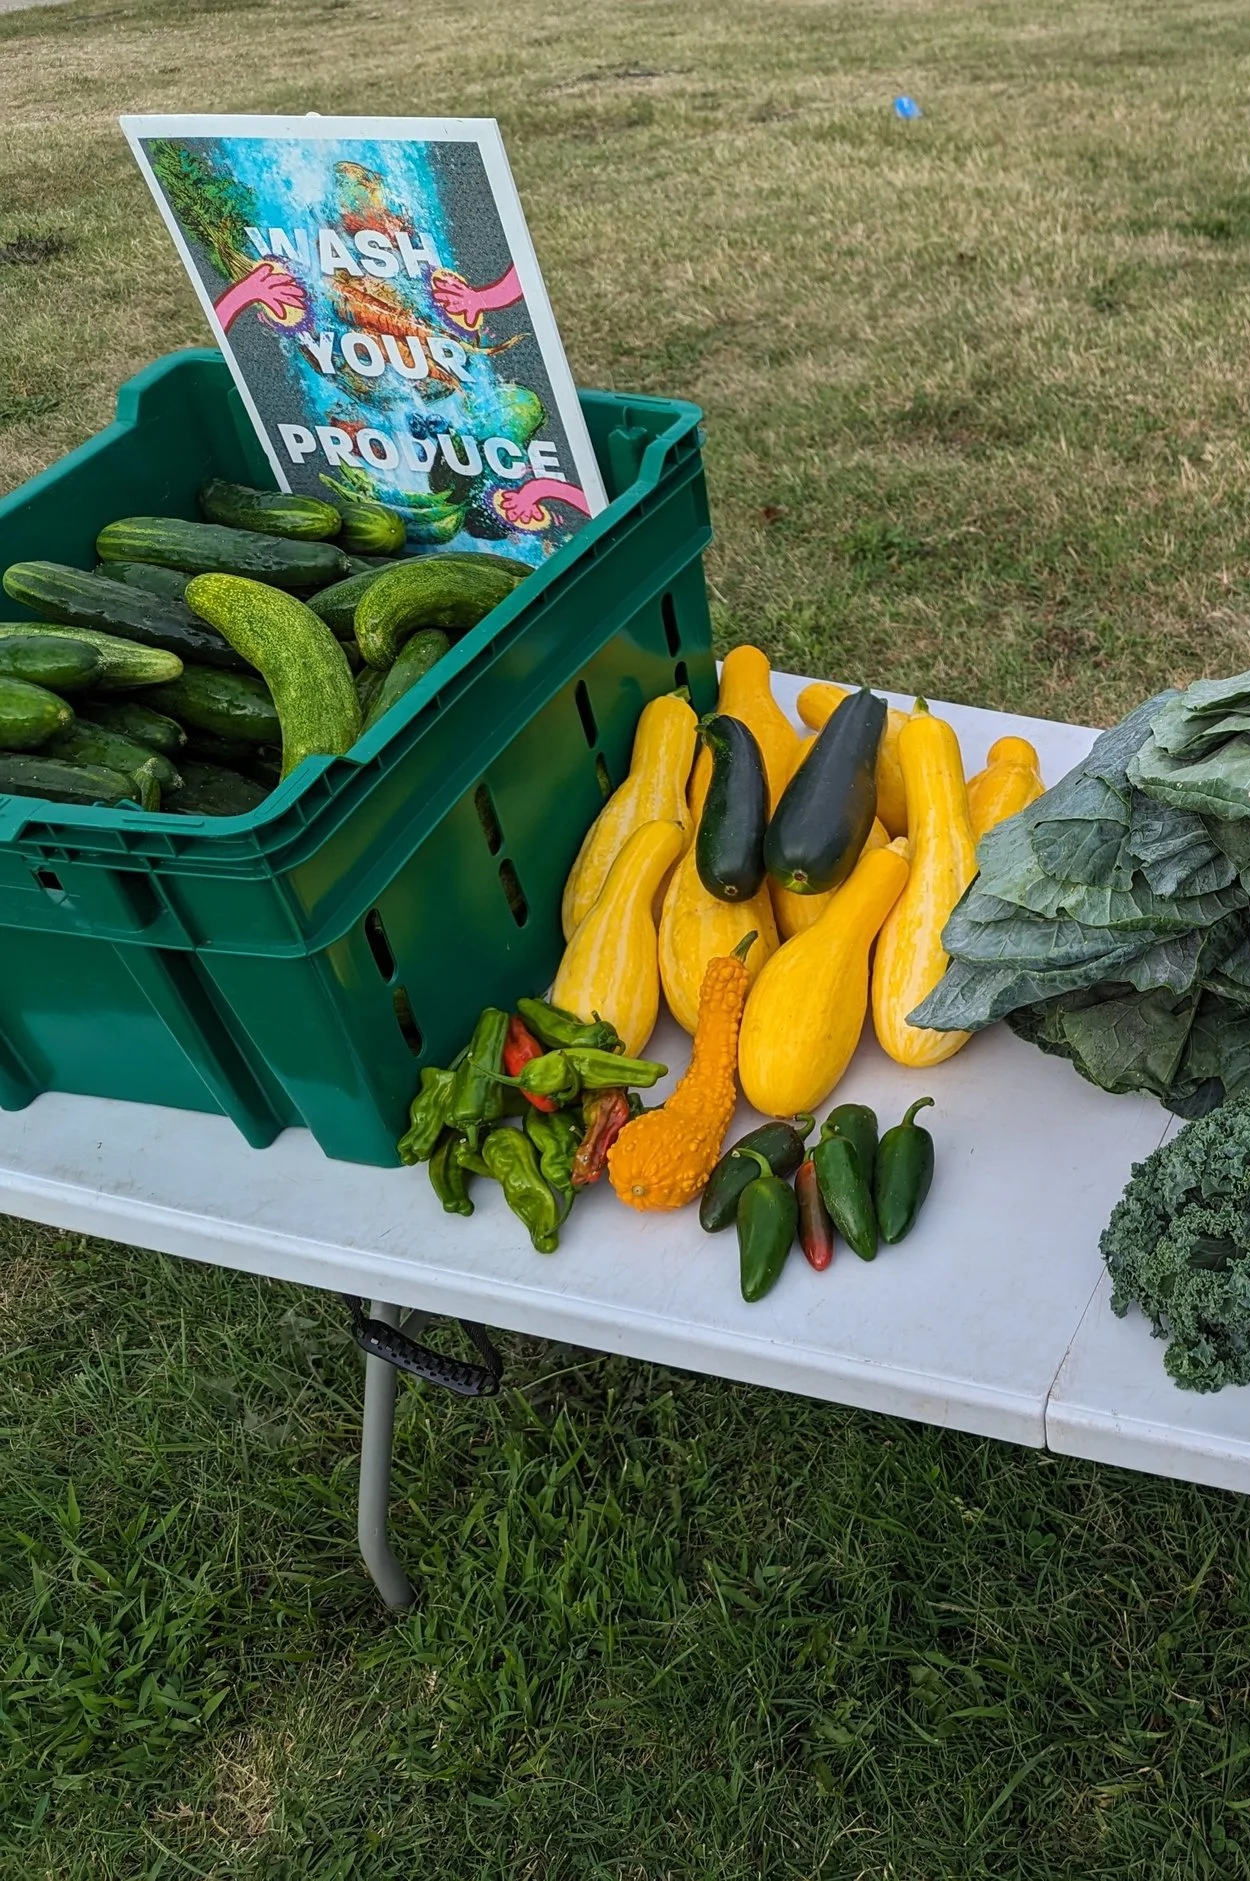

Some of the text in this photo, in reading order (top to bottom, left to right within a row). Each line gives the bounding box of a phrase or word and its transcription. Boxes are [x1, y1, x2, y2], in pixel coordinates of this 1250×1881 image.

[244, 227, 443, 278] WASH
[298, 331, 477, 383] YOUR
[277, 424, 566, 482] PRODUCE
